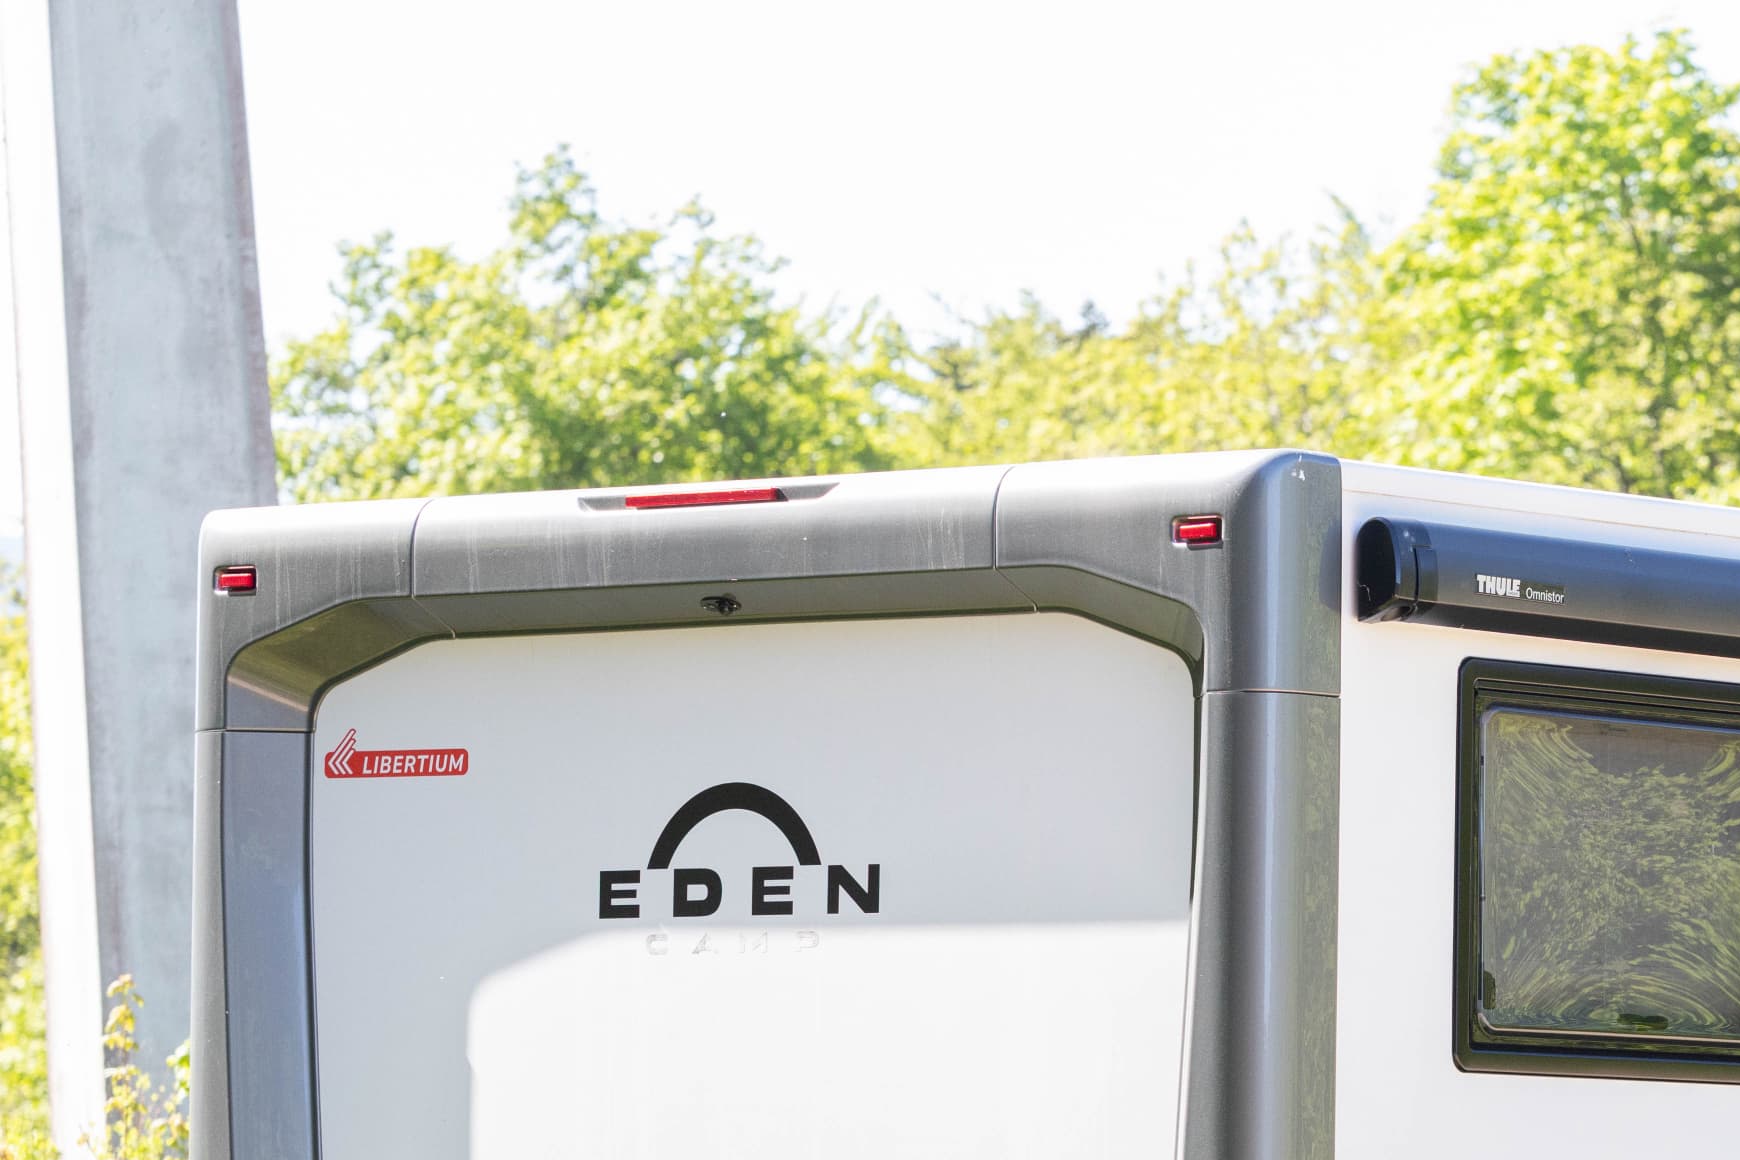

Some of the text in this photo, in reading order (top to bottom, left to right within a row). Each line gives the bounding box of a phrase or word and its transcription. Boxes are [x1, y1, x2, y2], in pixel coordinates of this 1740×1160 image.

[1476, 574, 1565, 604] THULE Omnistor
[362, 753, 465, 775] LIBERTIUM
[598, 863, 881, 920] EDEN
